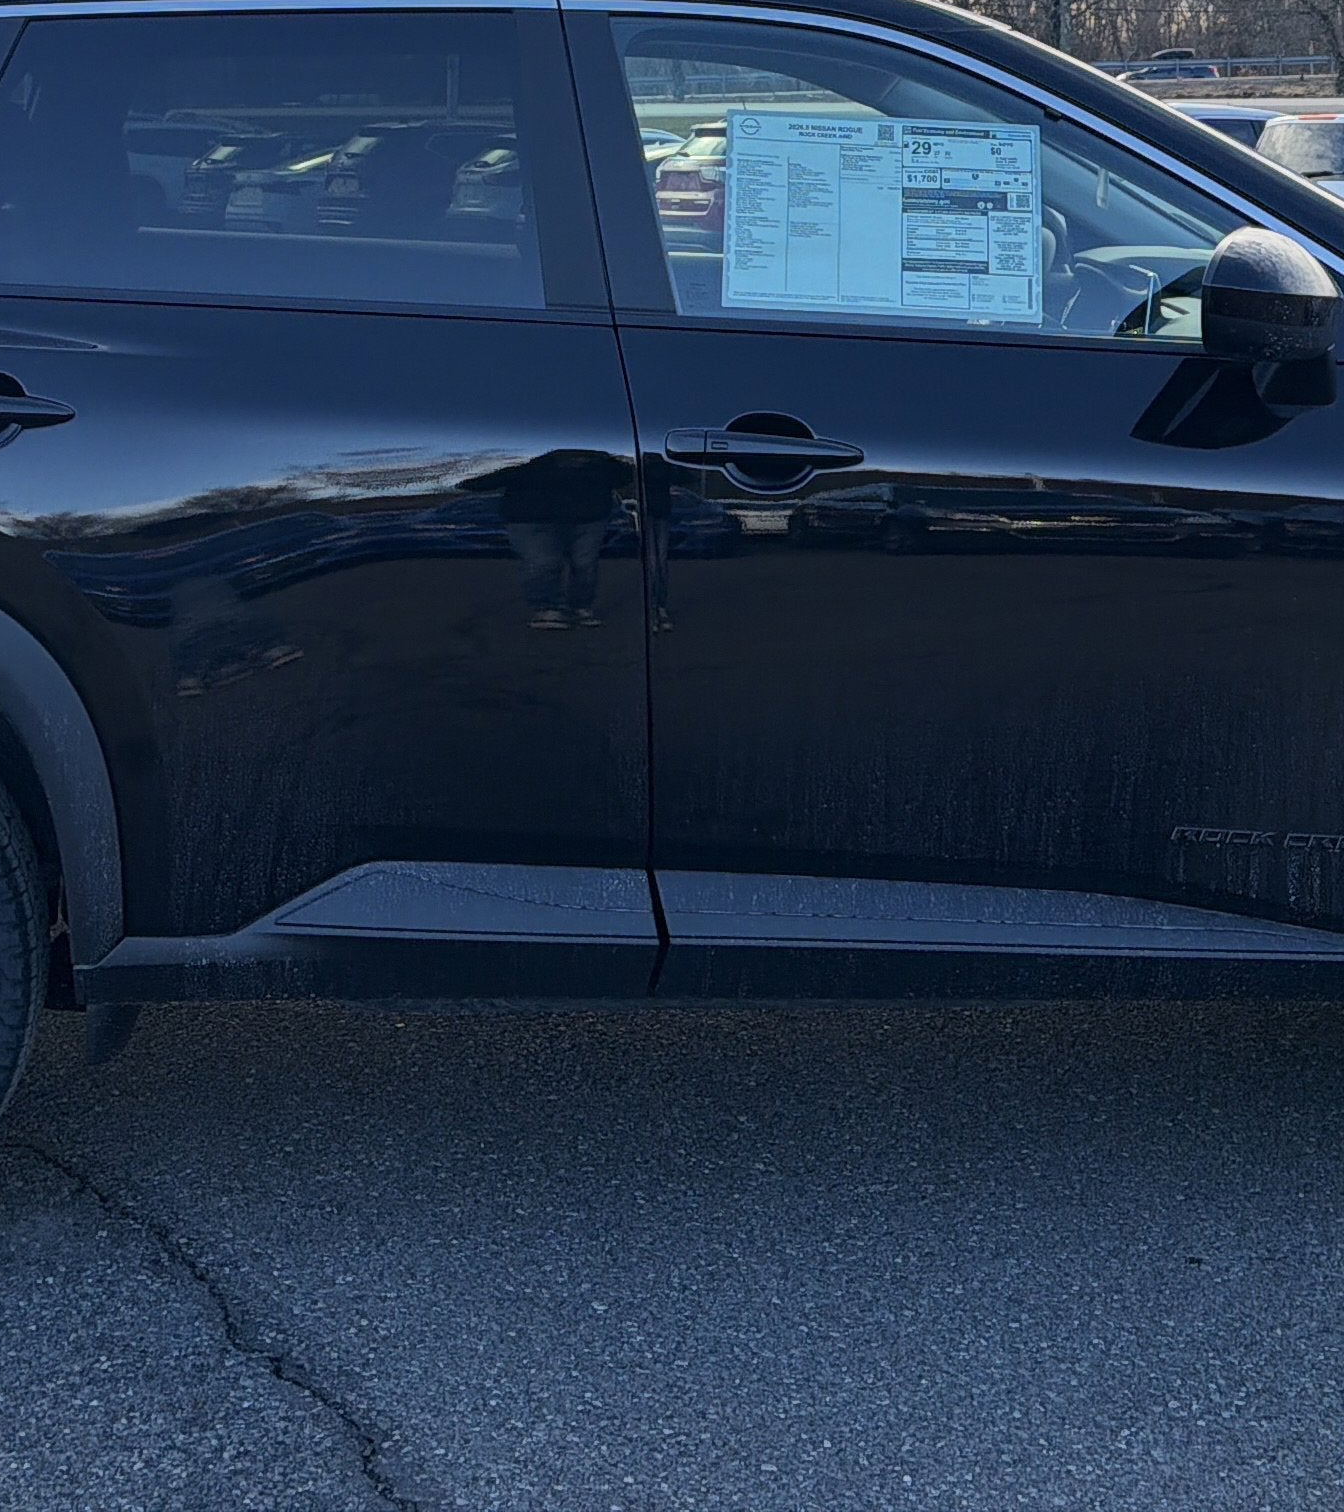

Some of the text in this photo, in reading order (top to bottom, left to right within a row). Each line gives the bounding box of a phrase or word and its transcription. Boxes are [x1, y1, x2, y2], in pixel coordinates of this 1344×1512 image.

[911, 141, 932, 155] 29
[906, 174, 938, 184] $1,700
[1170, 826, 1277, 846] ROCK
